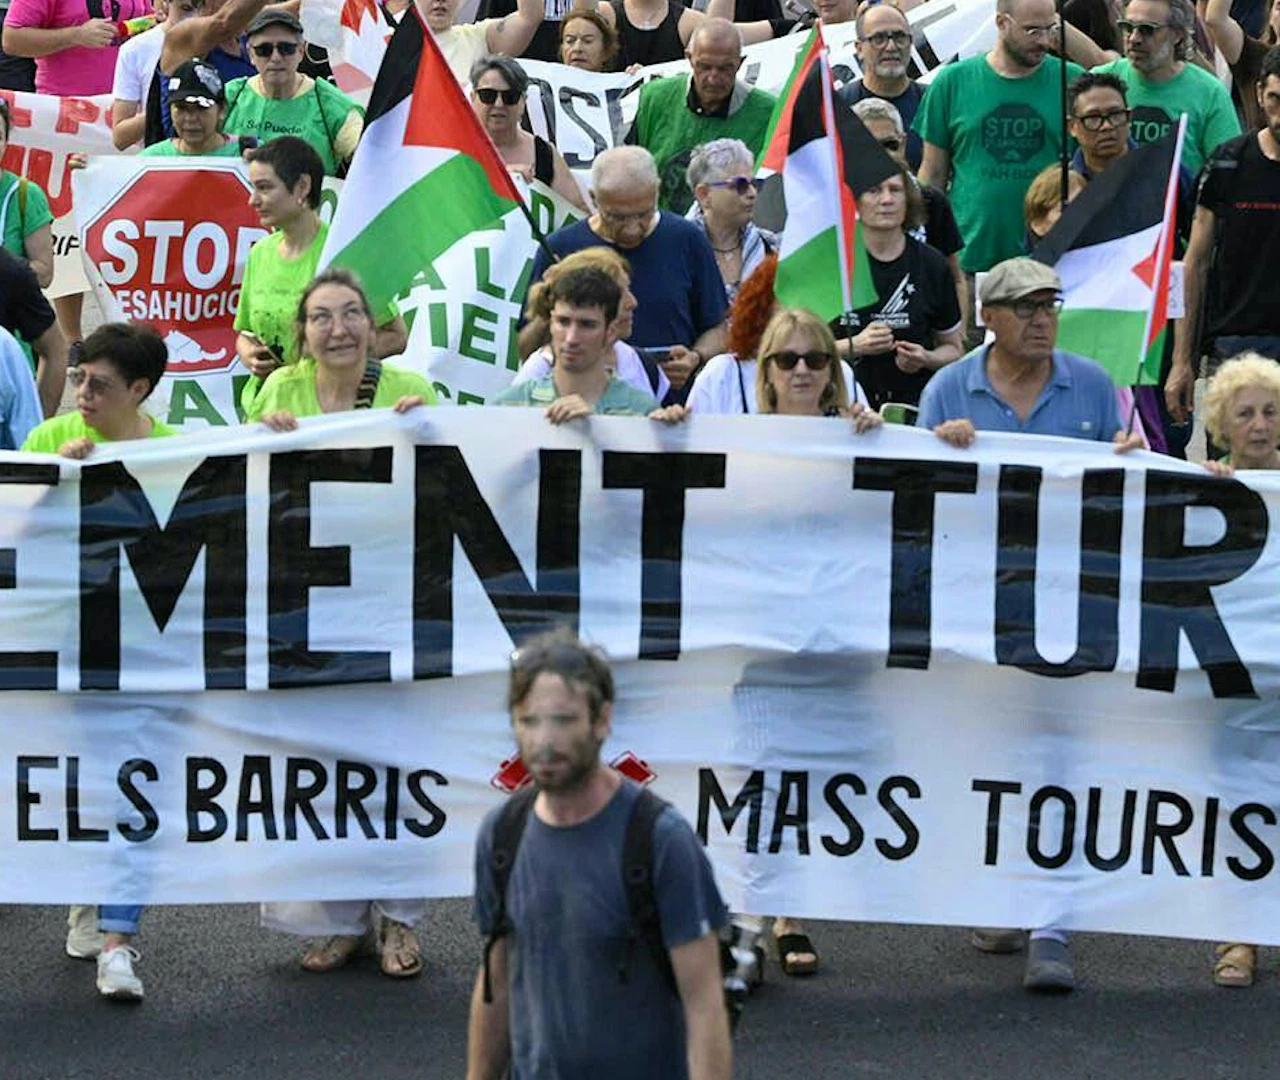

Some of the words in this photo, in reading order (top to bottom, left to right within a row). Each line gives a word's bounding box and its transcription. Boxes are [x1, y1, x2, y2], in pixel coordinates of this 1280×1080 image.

[984, 117, 1043, 140] STOP
[17, 754, 160, 845] ELS
[185, 755, 450, 843] BARRIS
[695, 766, 921, 862] MASS
